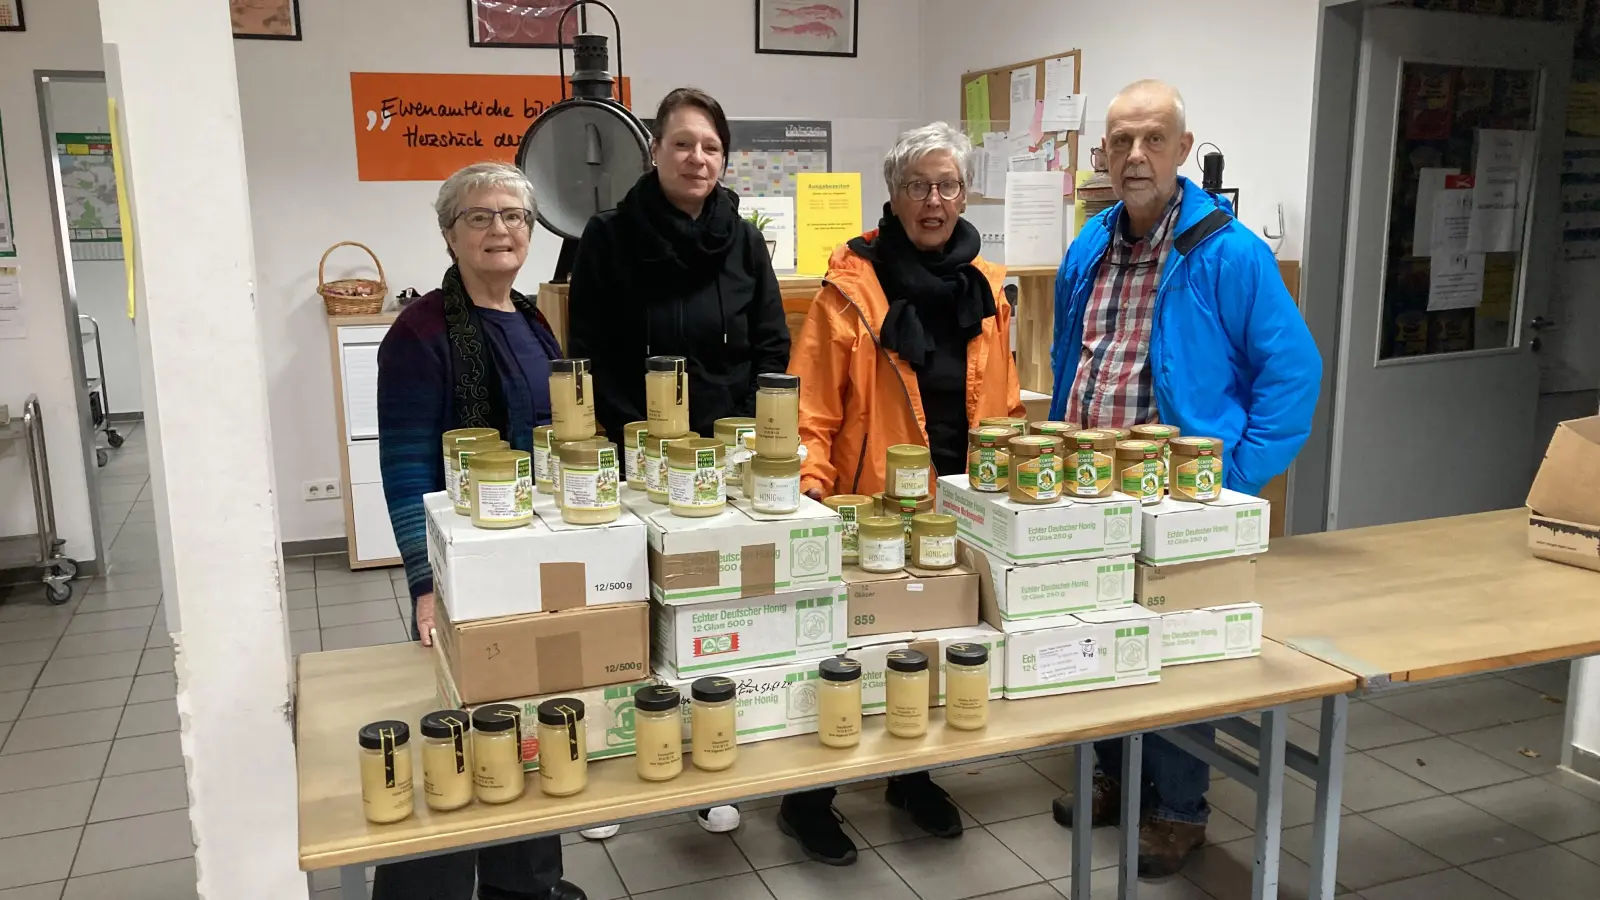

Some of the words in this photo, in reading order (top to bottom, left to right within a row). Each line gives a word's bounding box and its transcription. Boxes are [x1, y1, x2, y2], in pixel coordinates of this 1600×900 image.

[1028, 527, 1047, 535] Echter
[1048, 523, 1078, 533] Deutscher
[1079, 521, 1096, 530] Honig
[1167, 530, 1184, 539] Echter
[1185, 526, 1212, 536] Deutscher
[1212, 524, 1229, 533] Honig
[1021, 585, 1040, 594] Echter
[1041, 582, 1071, 592] Deutscher
[1071, 580, 1089, 588] Honig
[1147, 595, 1166, 607] 859
[692, 613, 719, 624] Echter
[720, 606, 762, 620] Deutscher
[763, 602, 787, 614] Honig
[692, 625, 703, 633] 12
[703, 622, 726, 632] Glas
[727, 619, 746, 629] 500
[746, 619, 754, 627] g
[854, 614, 876, 626] 859
[1022, 654, 1036, 664] Ech
[862, 671, 883, 681] chter
[754, 693, 779, 706] Honig
